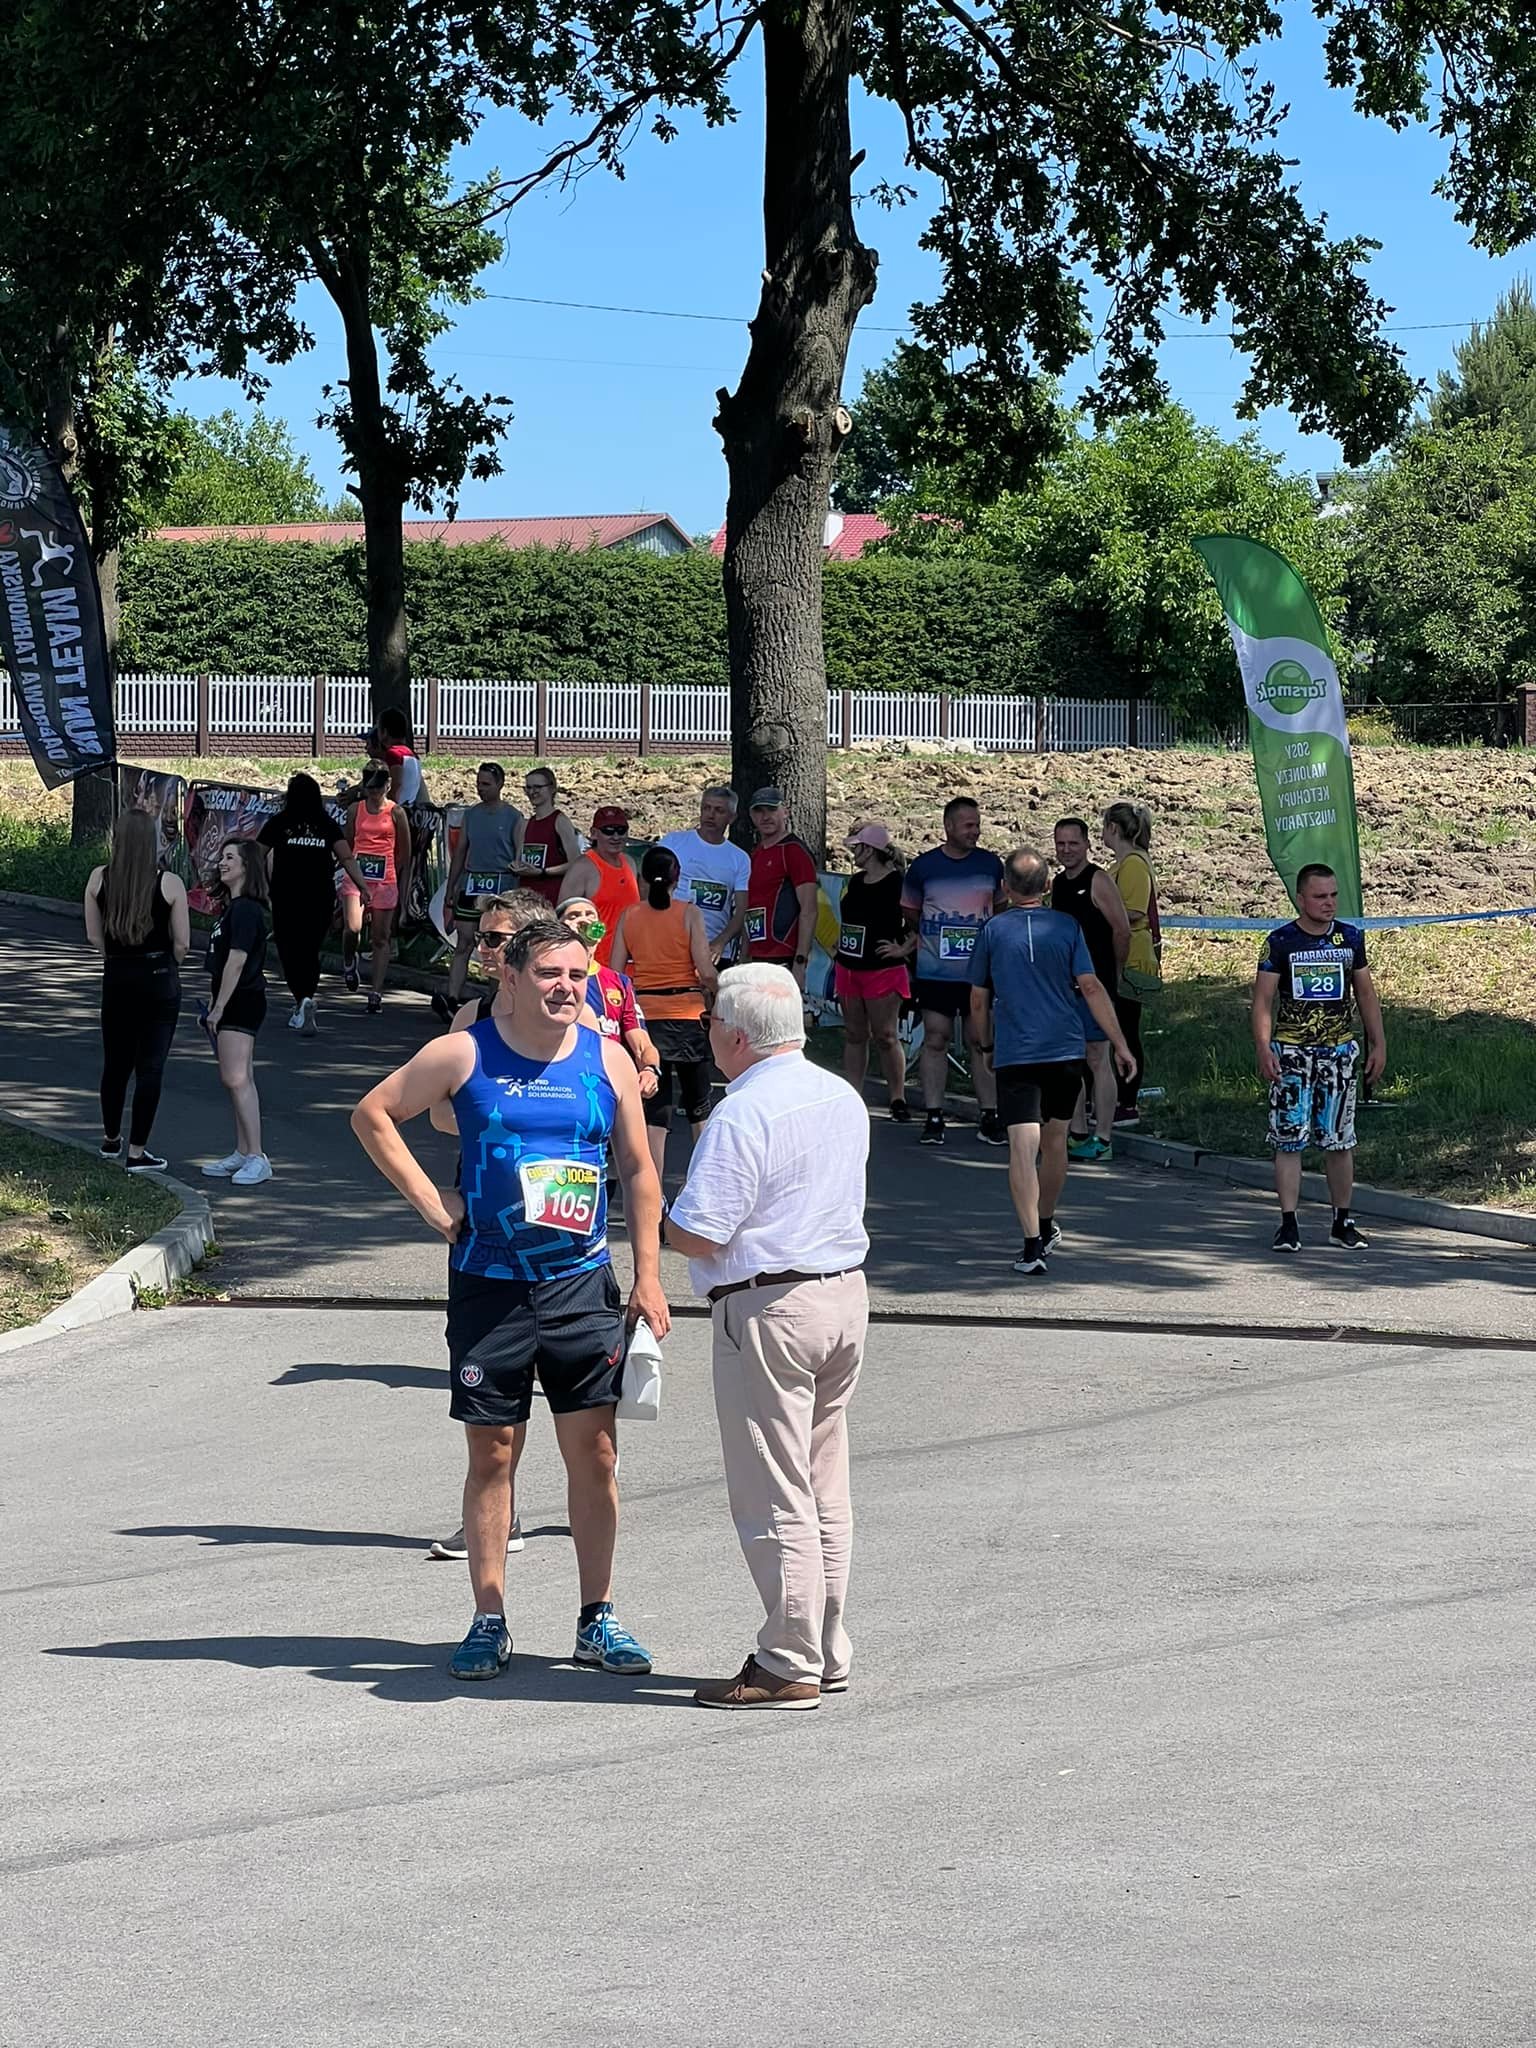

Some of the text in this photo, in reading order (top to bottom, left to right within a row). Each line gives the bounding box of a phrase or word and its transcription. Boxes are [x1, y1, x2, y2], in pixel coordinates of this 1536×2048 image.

[365, 862, 379, 873] 21
[477, 878, 495, 890] 40
[702, 891, 722, 906] 22
[749, 919, 761, 933] 24
[841, 937, 857, 950] 99
[1289, 948, 1353, 962] CHARAKTERNI
[1310, 976, 1334, 992] 28
[550, 1189, 592, 1222] 105
